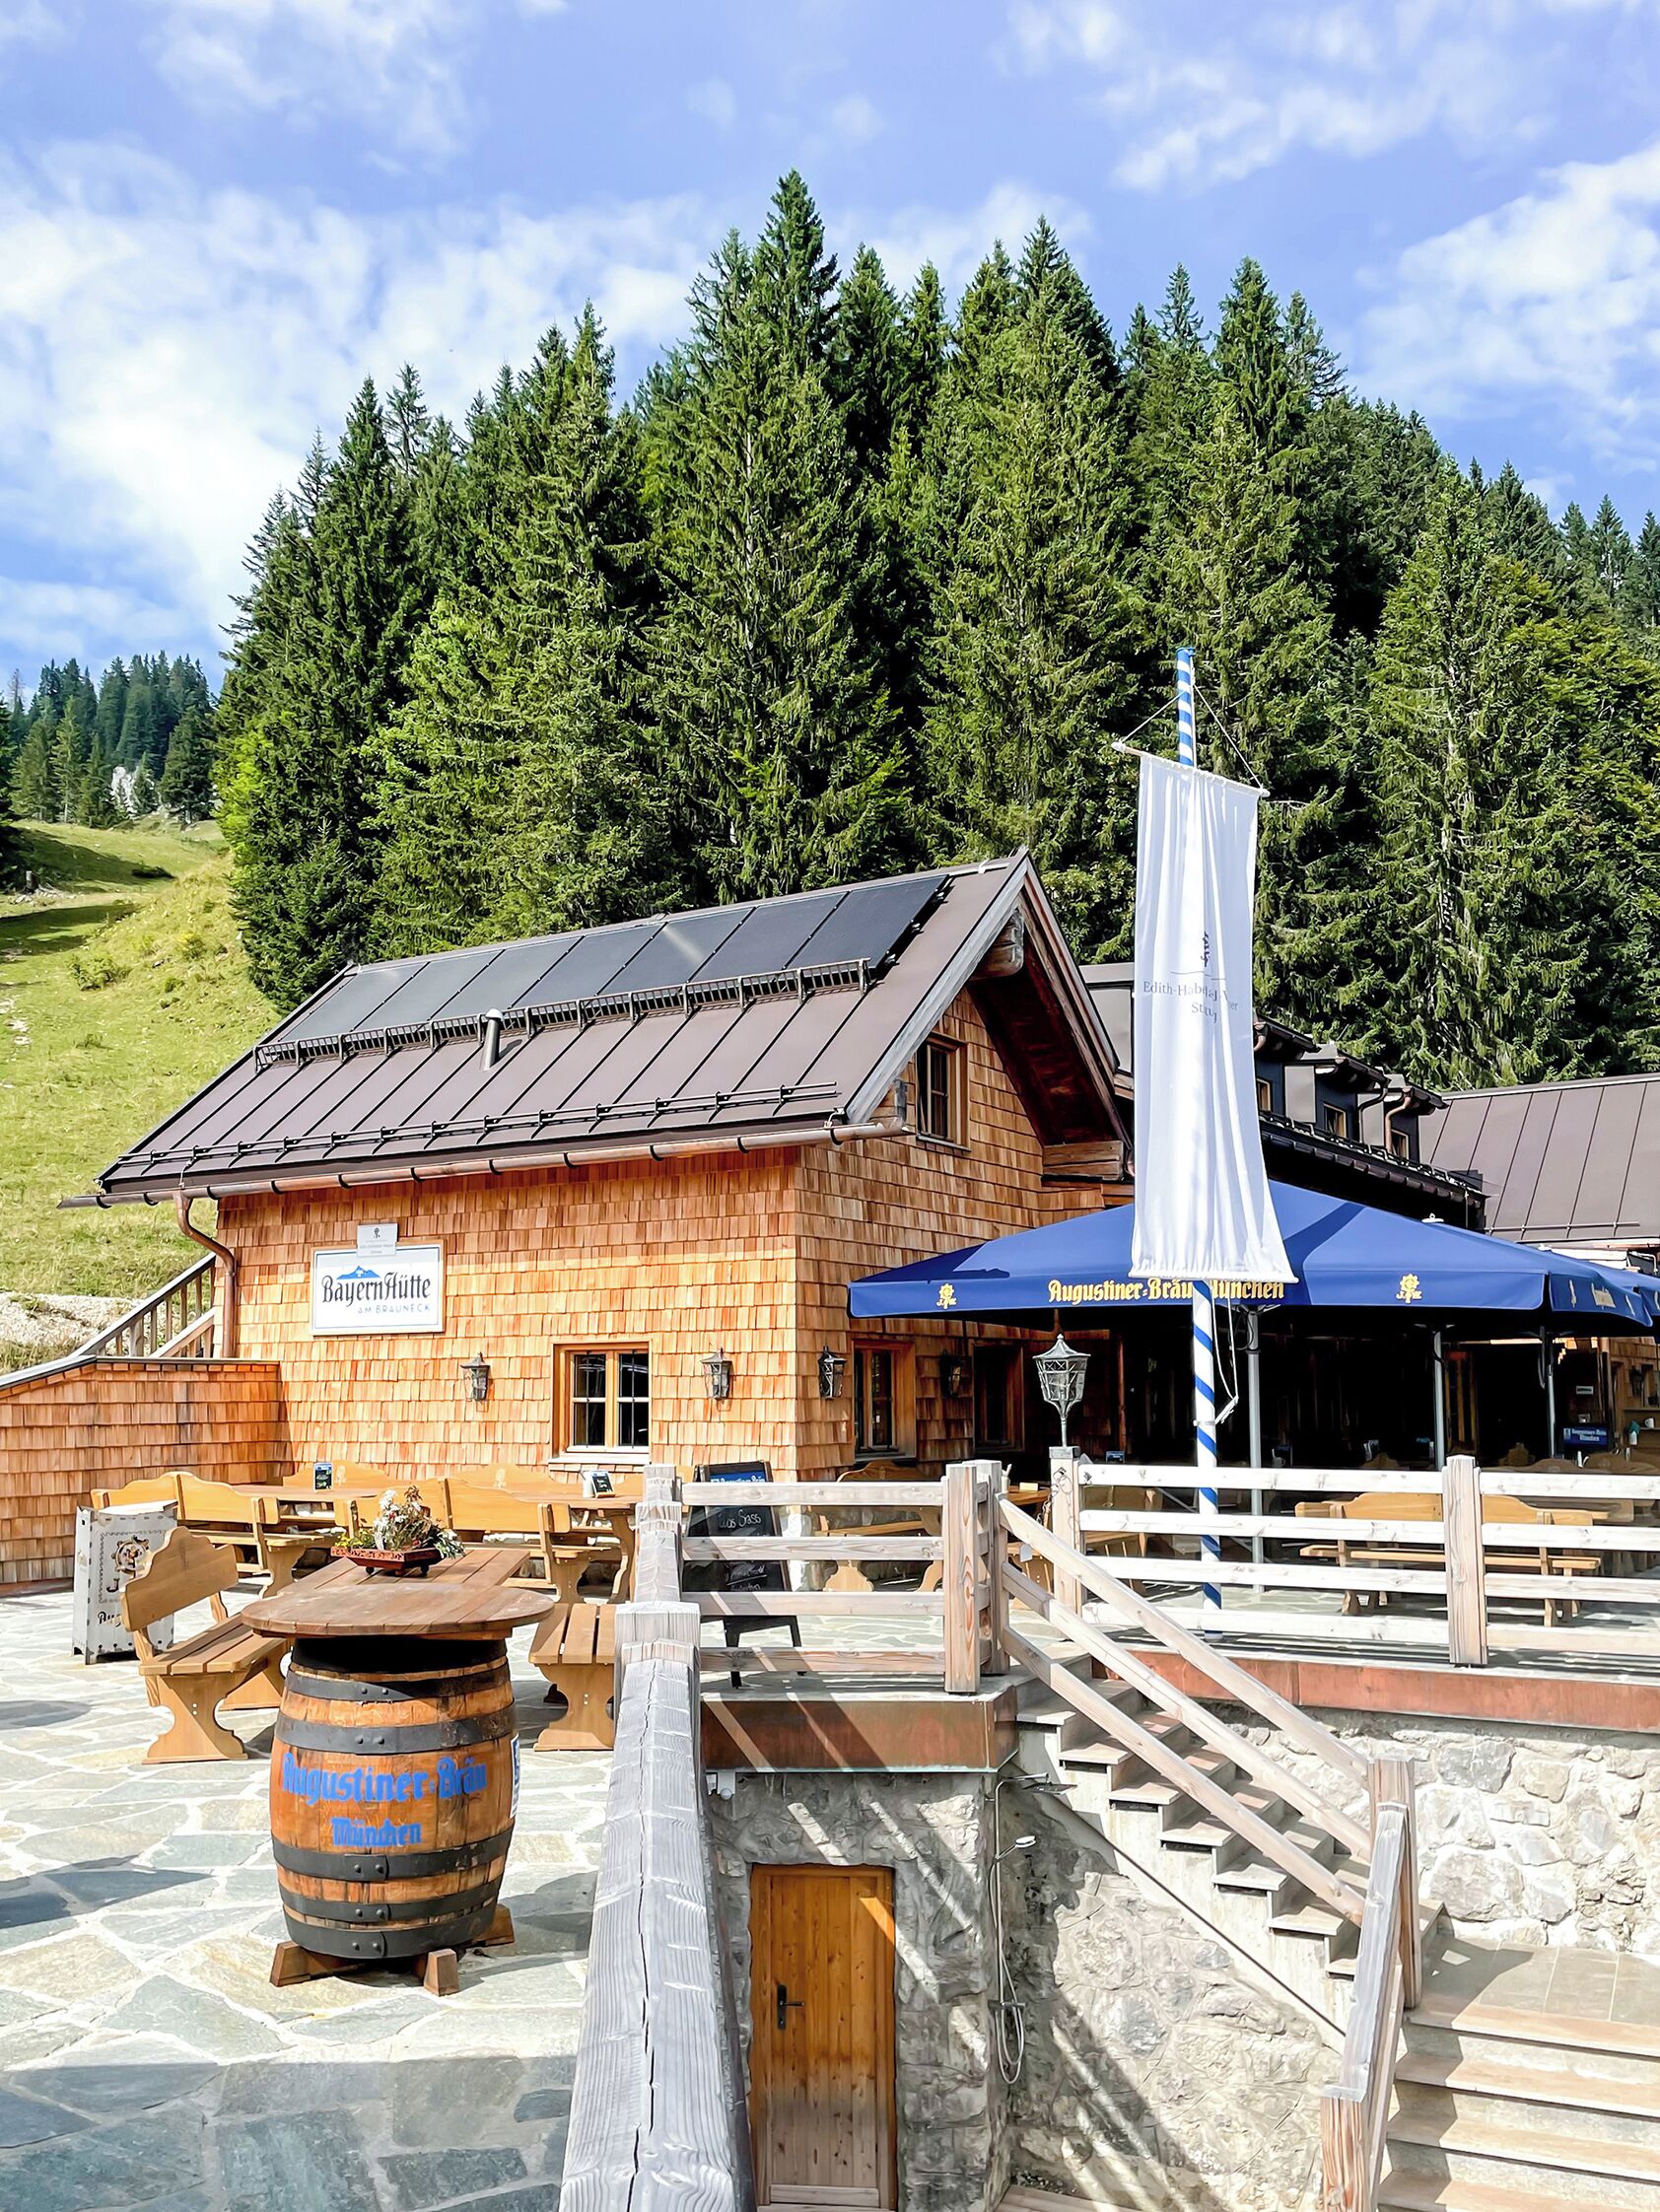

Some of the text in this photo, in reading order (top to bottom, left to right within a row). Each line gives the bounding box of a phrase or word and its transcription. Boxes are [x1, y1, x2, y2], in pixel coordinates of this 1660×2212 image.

[321, 1271, 431, 1307] BayernHütte
[376, 1303, 431, 1314] BRAUNECK
[331, 1817, 422, 1847] München
